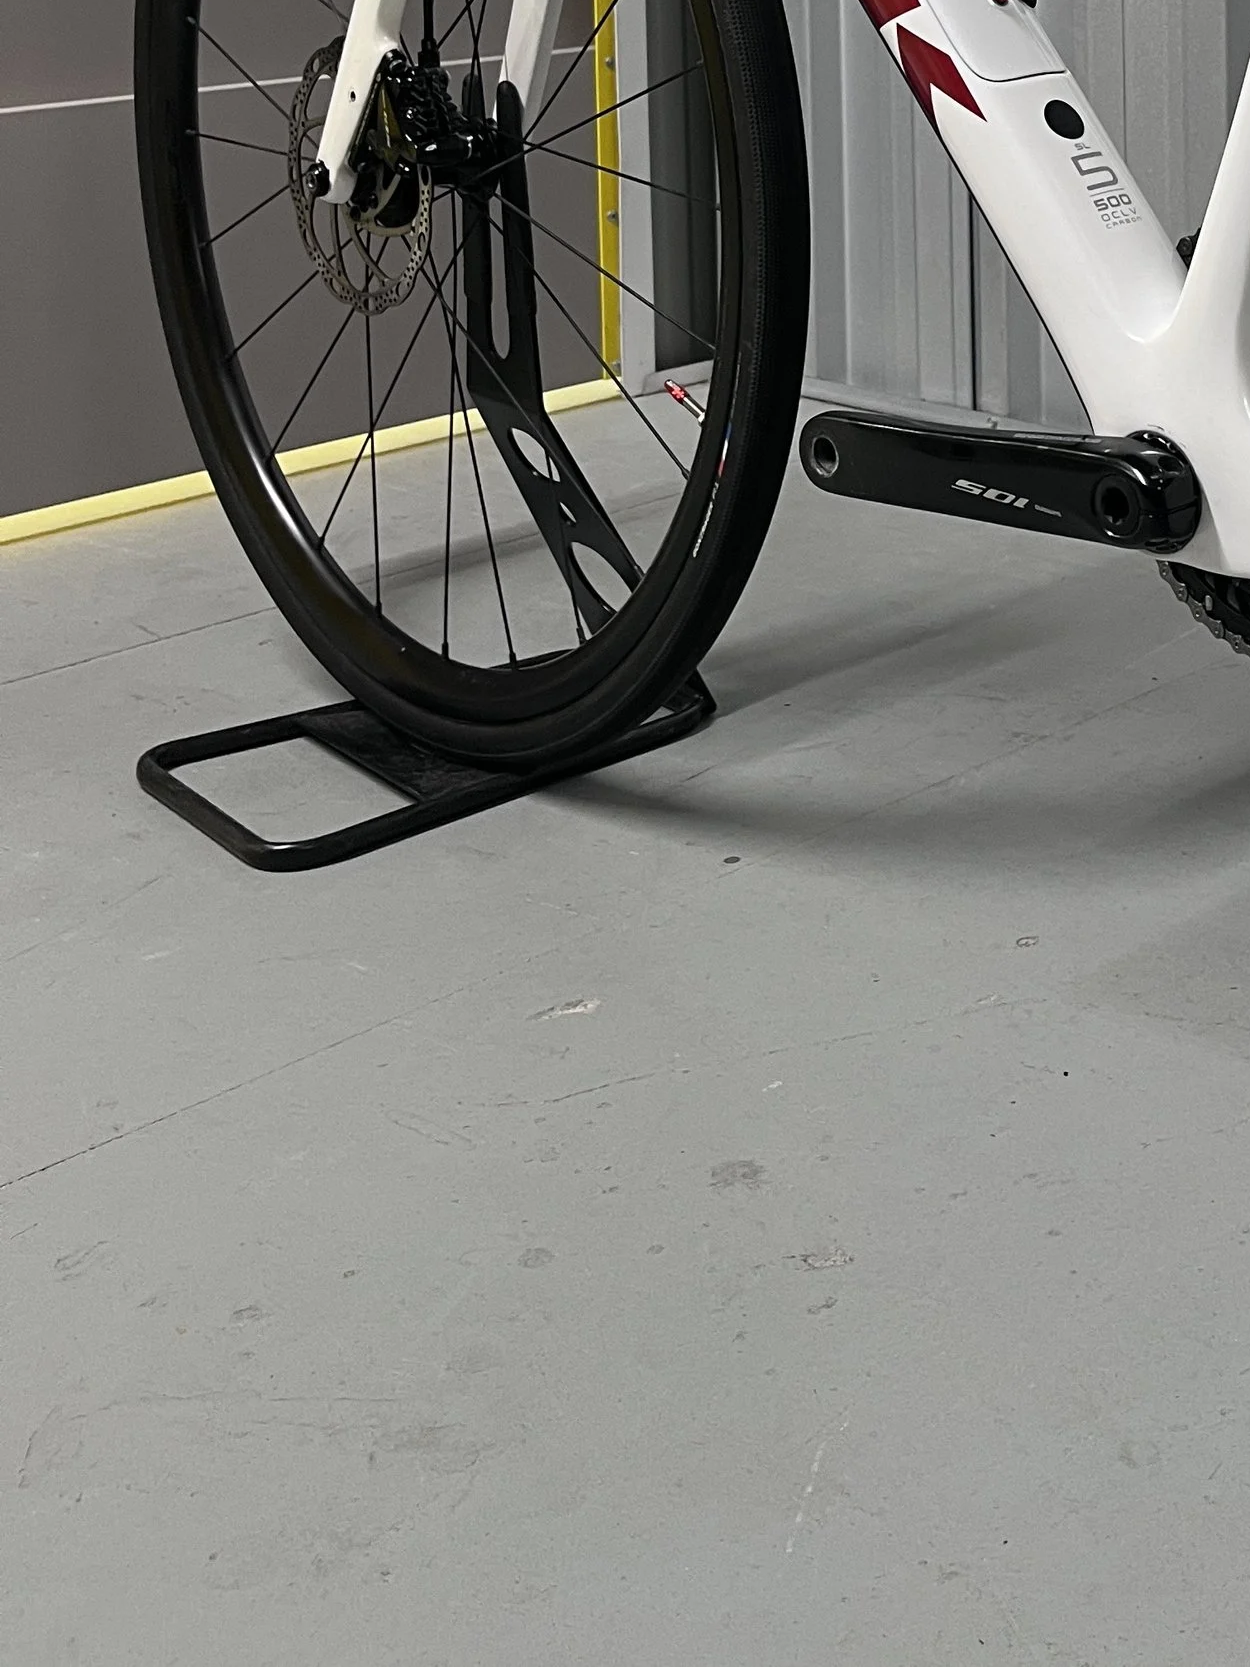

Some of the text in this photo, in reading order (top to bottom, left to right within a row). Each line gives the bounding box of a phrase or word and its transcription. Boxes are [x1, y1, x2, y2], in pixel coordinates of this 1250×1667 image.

[1074, 142, 1091, 151] SL
[1070, 151, 1118, 191] 5
[1093, 194, 1132, 212] 500
[1101, 207, 1137, 222] OCLV
[951, 479, 1030, 509] 105
